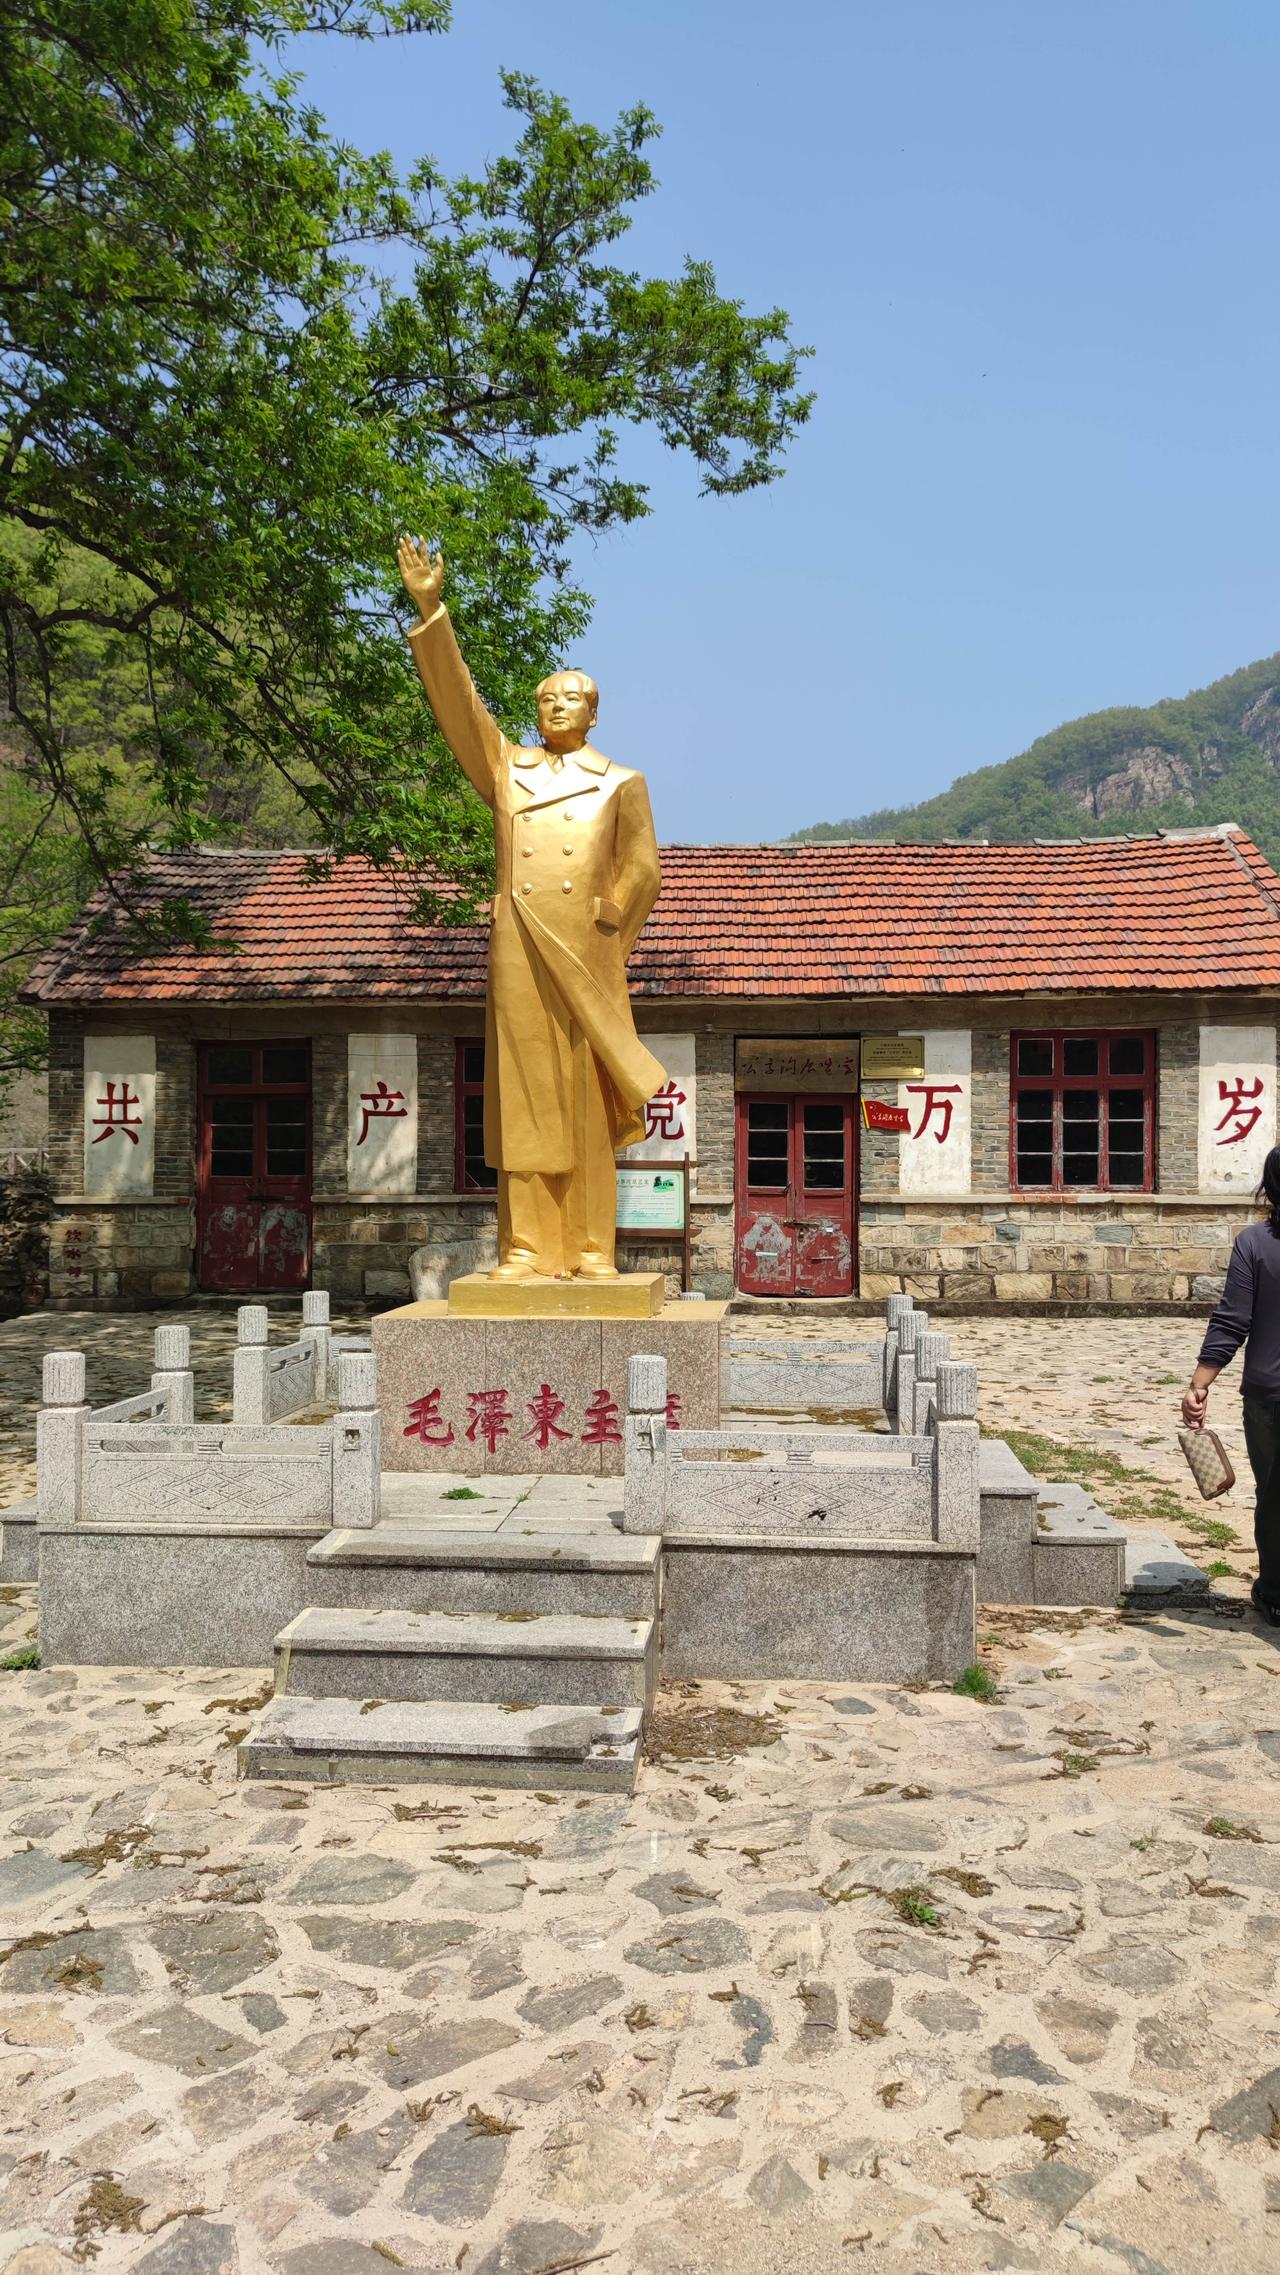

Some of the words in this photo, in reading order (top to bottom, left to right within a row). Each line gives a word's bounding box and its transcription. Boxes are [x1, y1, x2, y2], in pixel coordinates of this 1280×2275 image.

[91, 1081, 143, 1144] 共
[356, 1081, 408, 1145] 产
[645, 1080, 687, 1140] 党
[906, 1084, 963, 1144] 万
[1215, 1078, 1264, 1146] 岁
